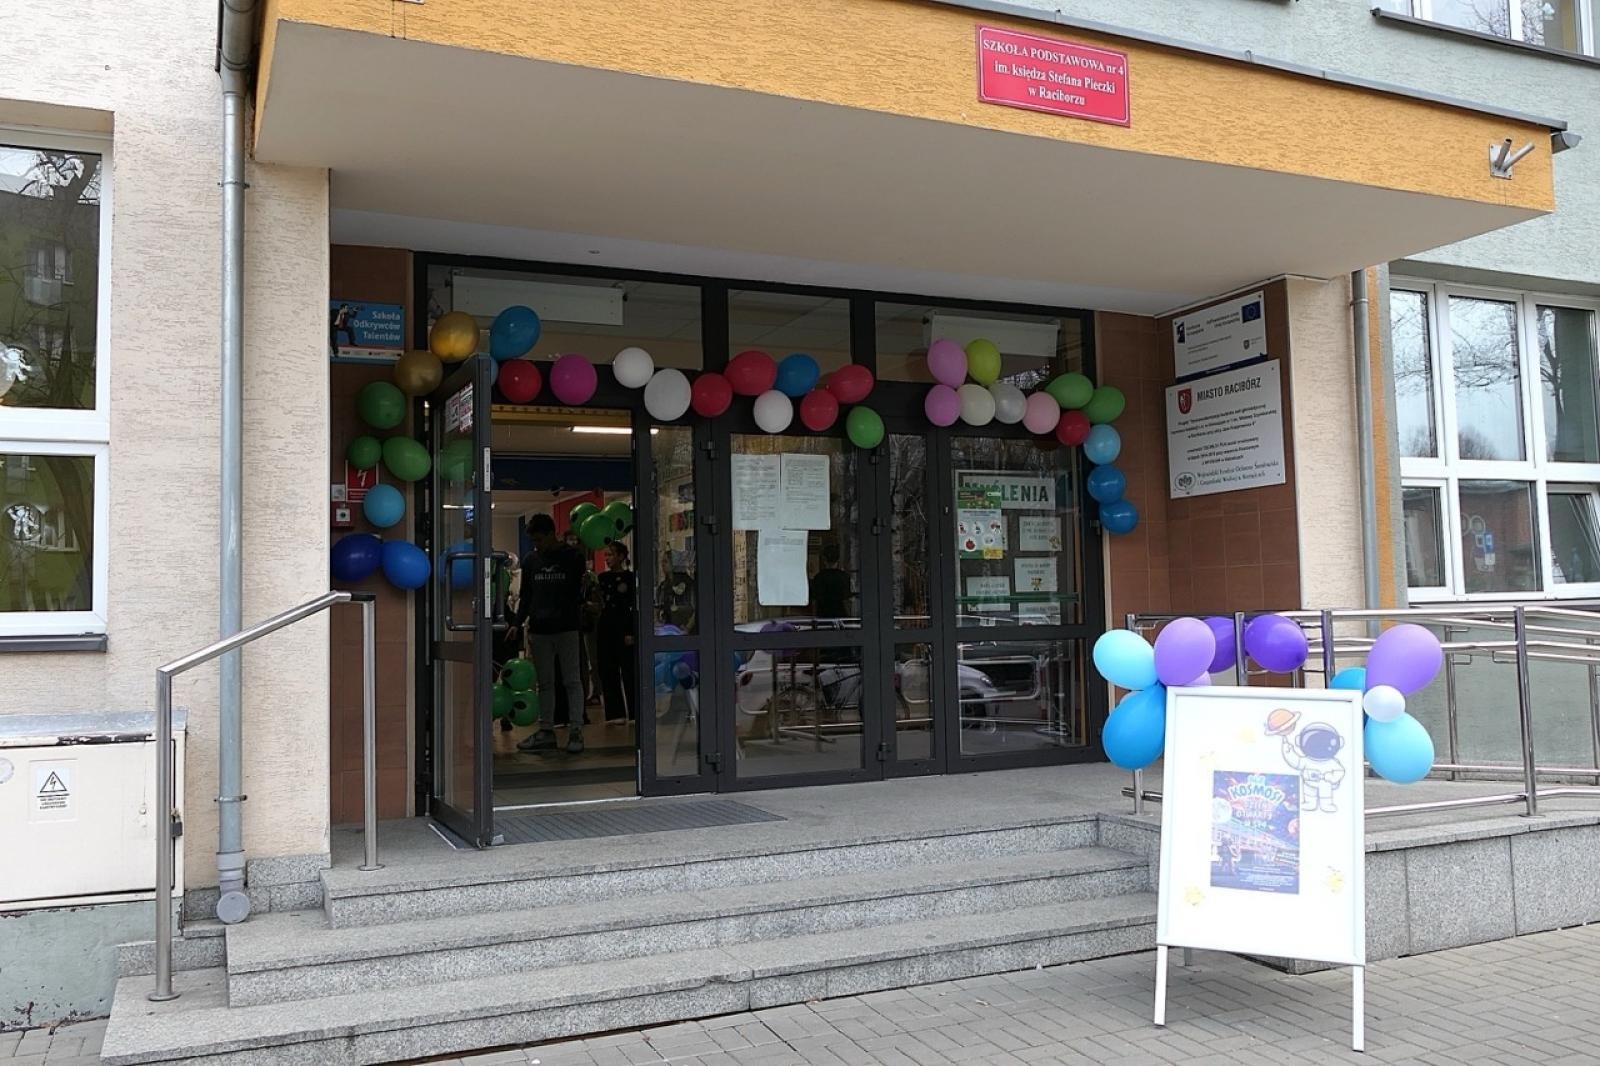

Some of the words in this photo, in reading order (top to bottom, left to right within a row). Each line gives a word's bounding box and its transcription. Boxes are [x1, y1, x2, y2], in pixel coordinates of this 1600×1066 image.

[983, 39, 1029, 56] SZKOŁA
[1031, 47, 1105, 73] PODSTAWOWA
[1106, 65, 1117, 74] nr
[1117, 65, 1124, 75] 4
[994, 60, 1010, 73] im.
[1012, 63, 1047, 81] księdza
[1048, 71, 1082, 87] Stefana
[1084, 77, 1116, 94] Pieczki
[1027, 87, 1037, 97] w
[1039, 86, 1086, 106] Raciborzu
[353, 319, 401, 331] Odkrywców
[372, 310, 401, 321] Szkoła
[363, 331, 401, 341] Talentów
[1197, 386, 1223, 402] MIASTO
[1224, 377, 1262, 396] RACIBÓRZ
